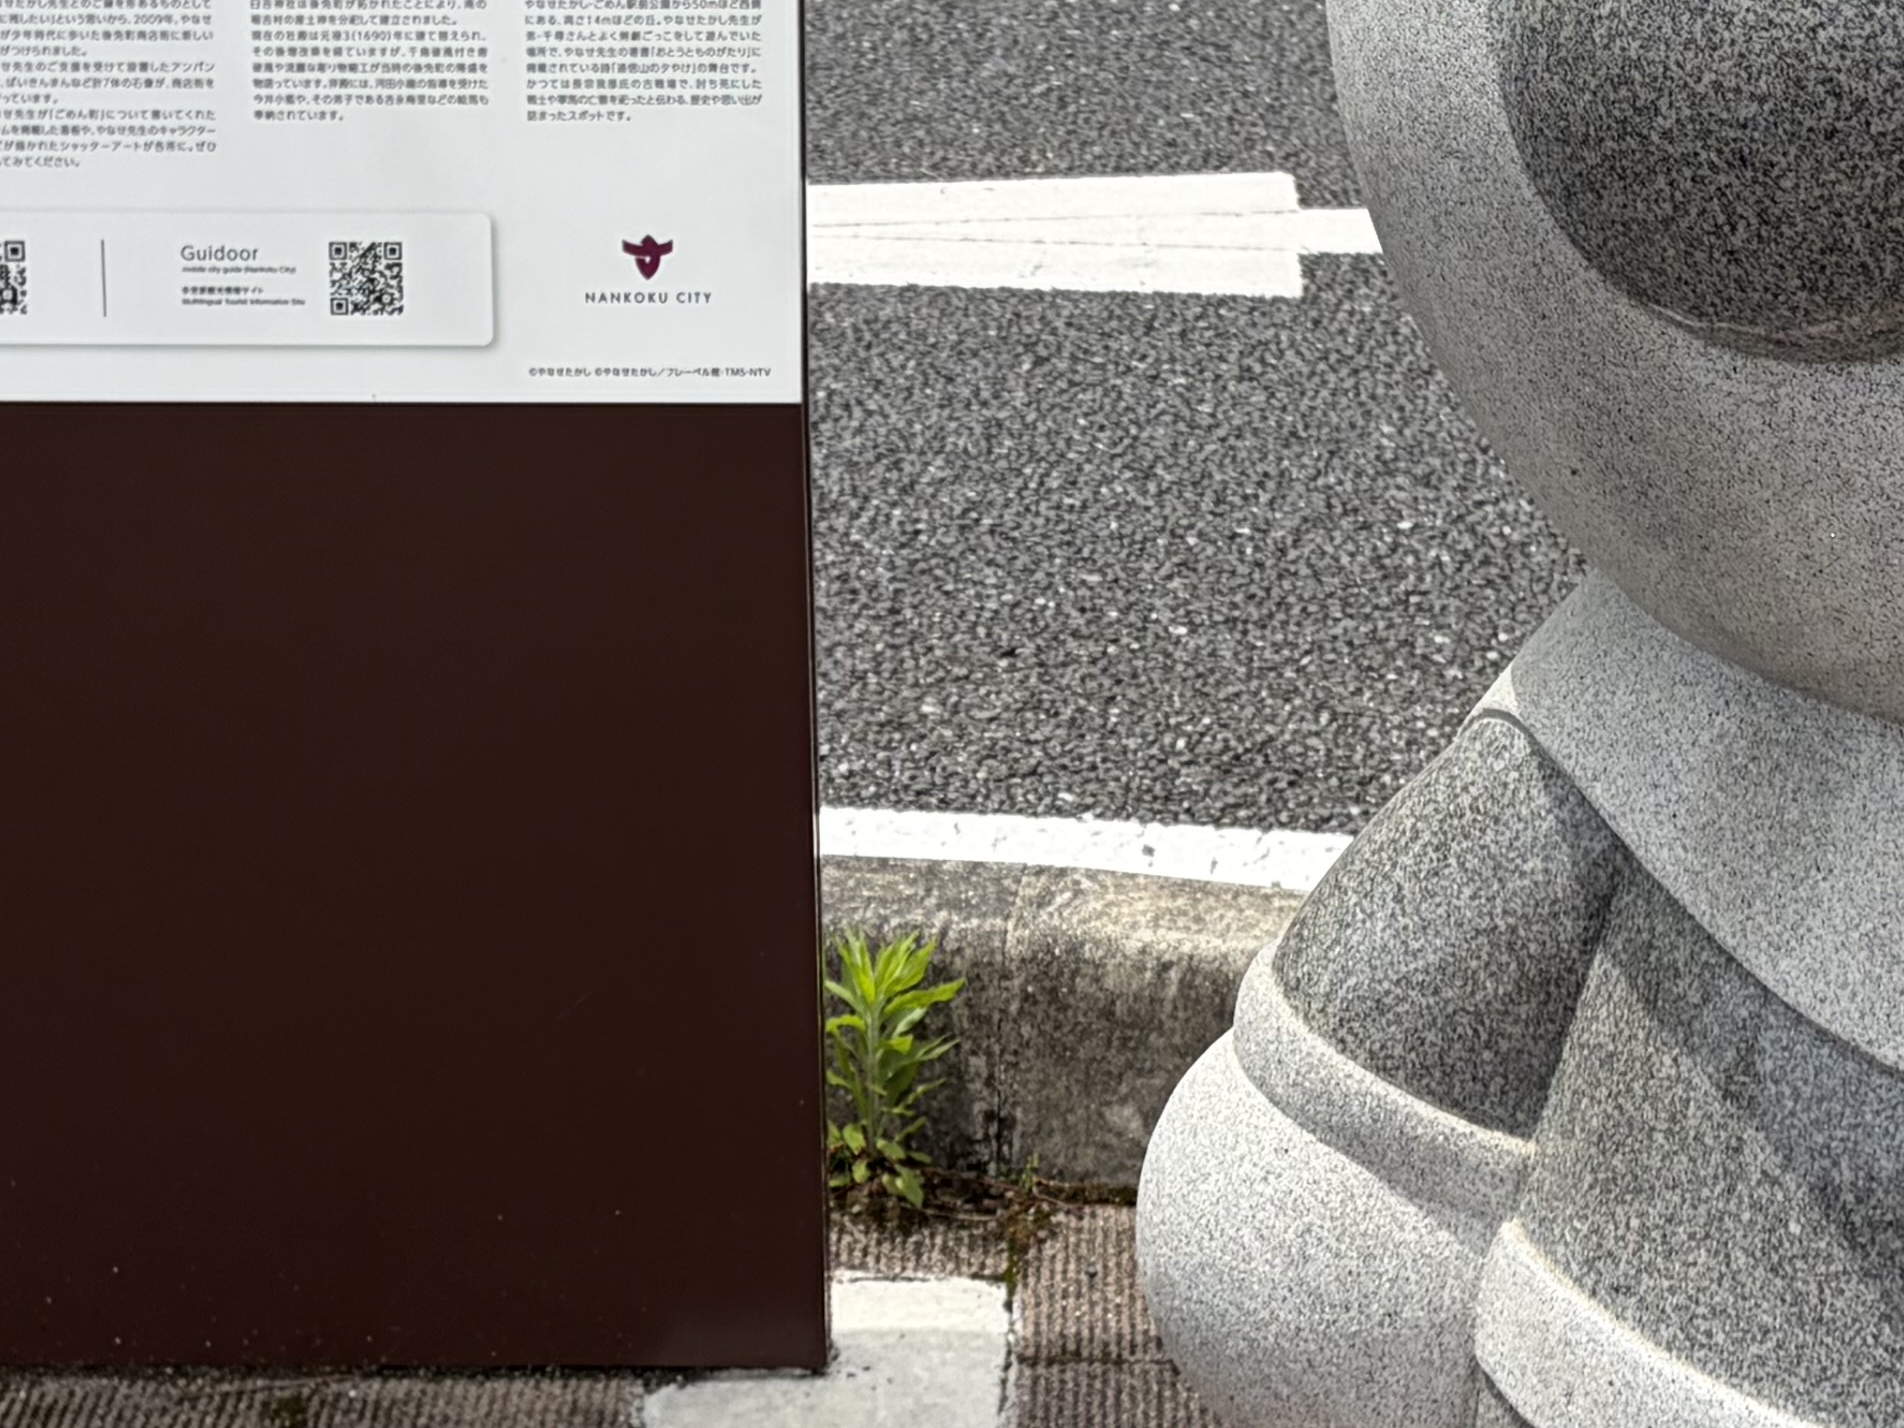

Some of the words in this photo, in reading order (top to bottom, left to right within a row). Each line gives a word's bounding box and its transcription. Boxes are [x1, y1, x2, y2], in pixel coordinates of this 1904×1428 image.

[180, 245, 258, 261] Guidoor
[585, 291, 669, 304] NANKOKU
[676, 291, 712, 304] CITY
